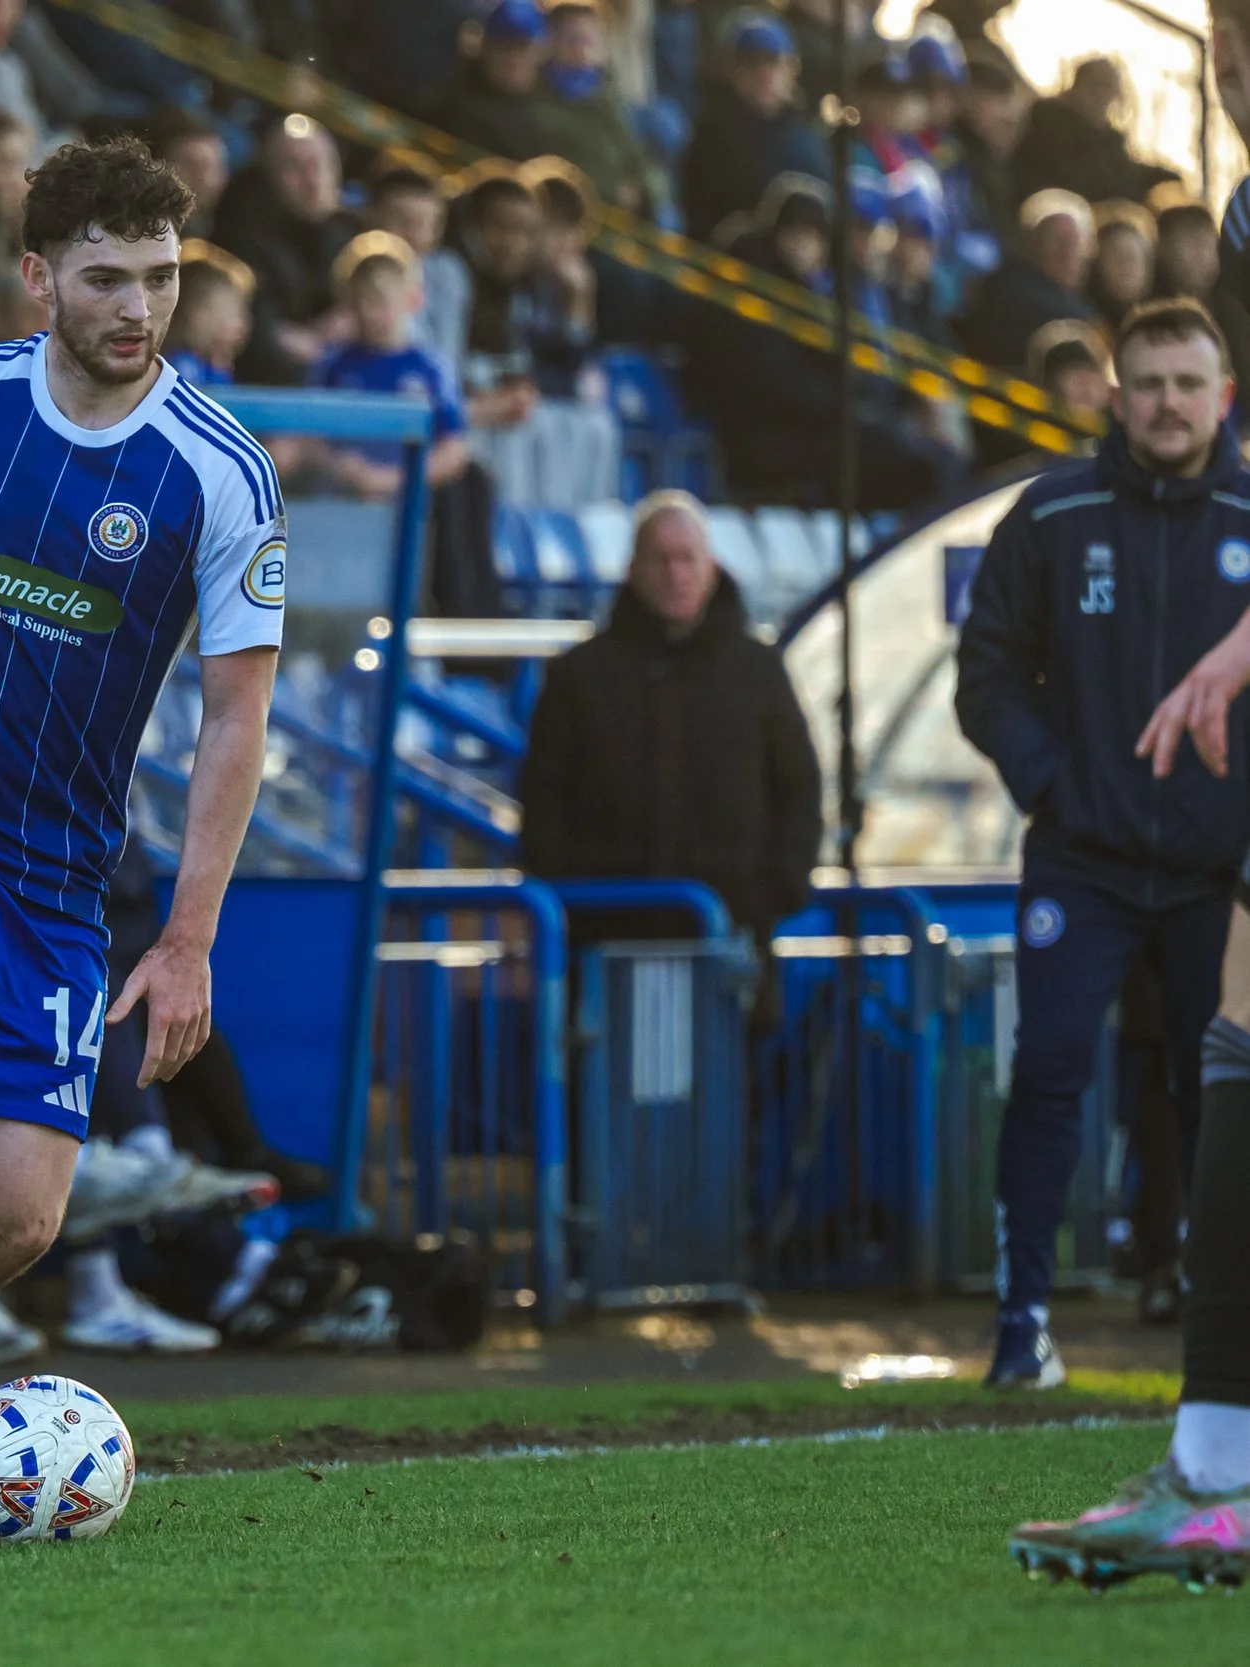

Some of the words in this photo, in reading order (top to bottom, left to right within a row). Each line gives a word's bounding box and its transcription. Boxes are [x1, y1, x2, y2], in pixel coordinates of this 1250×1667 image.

[97, 507, 123, 520] CURZON
[126, 509, 144, 532] ASHTON
[92, 532, 120, 557] FOOTBALL
[122, 544, 140, 557] CLUB
[261, 561, 284, 588] B
[23, 616, 83, 647] Supplies
[43, 987, 103, 1074] 14
